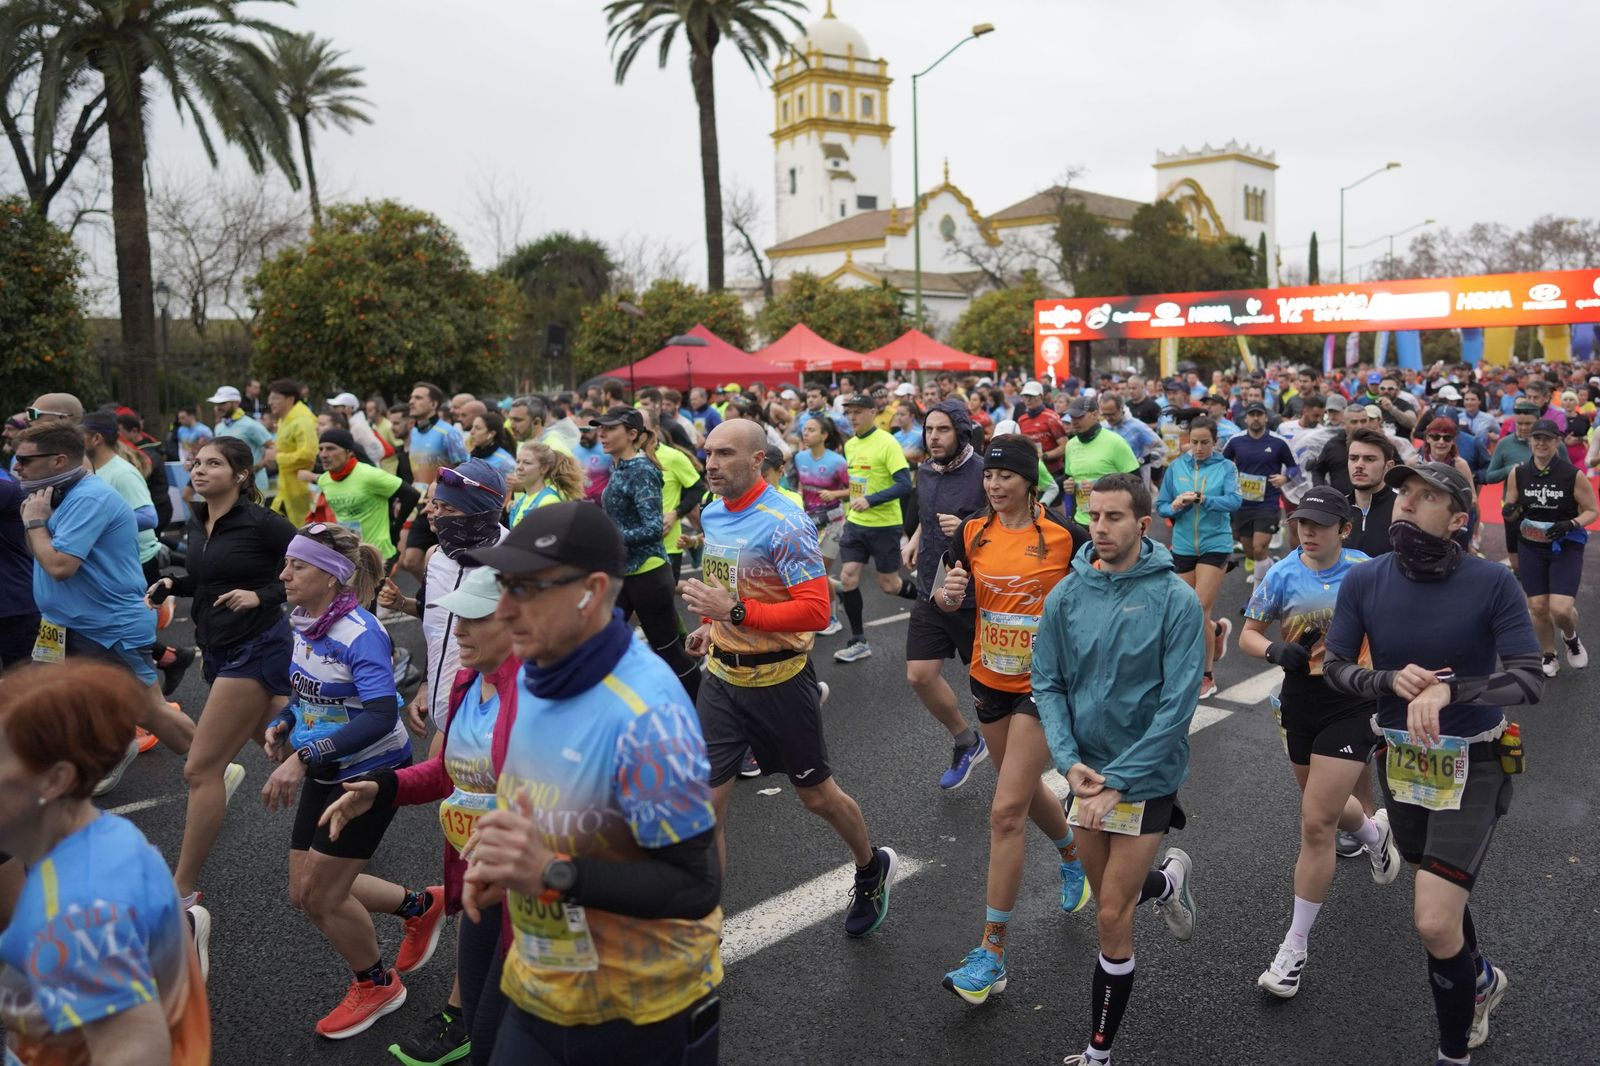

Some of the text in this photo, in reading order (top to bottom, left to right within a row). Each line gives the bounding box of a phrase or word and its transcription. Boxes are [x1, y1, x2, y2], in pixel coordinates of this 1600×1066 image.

[984, 623, 1031, 649] 18579
[291, 671, 321, 698] CORRE
[1394, 745, 1455, 778] 12616
